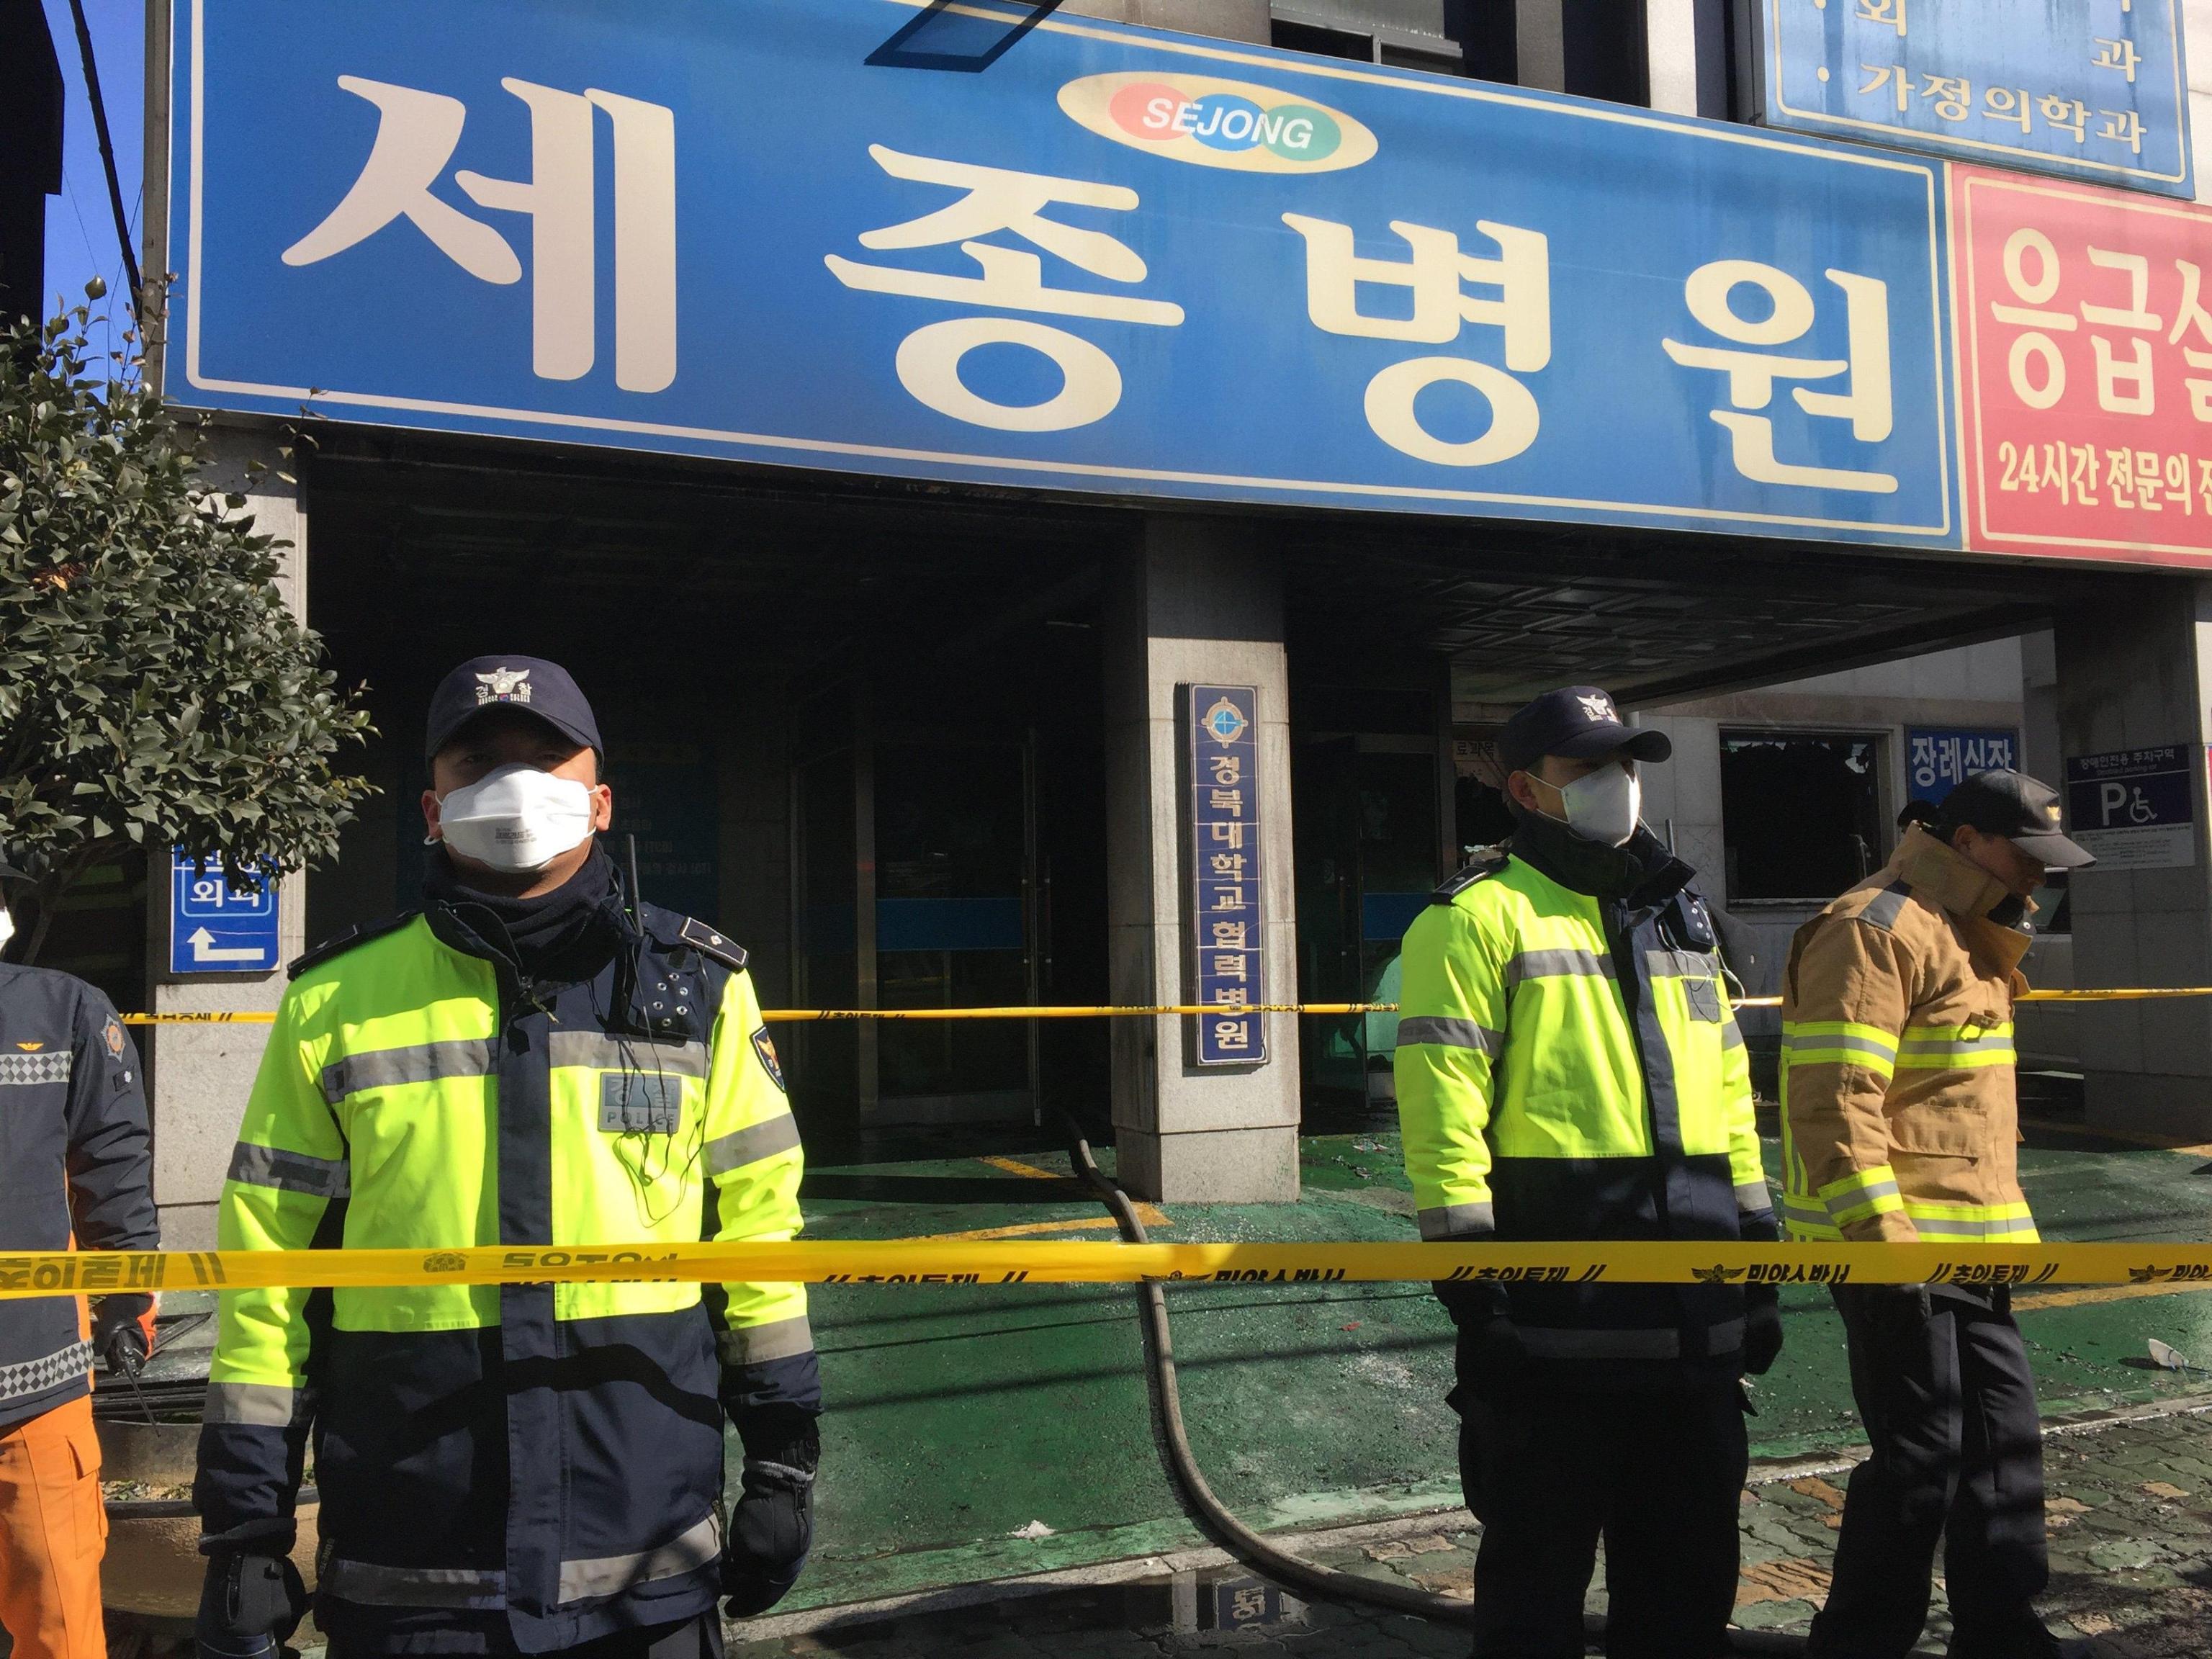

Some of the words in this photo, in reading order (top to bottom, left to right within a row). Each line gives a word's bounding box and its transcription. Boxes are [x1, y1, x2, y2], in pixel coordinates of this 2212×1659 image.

[2092, 37, 2141, 82] 과
[1142, 97, 1314, 149] SEJONG
[1858, 63, 2147, 154] 가정의학과
[281, 74, 1899, 493] 세종병원
[1998, 440, 2100, 505] 24시간
[2105, 446, 2193, 516] 전문의
[2080, 754, 2129, 771] 장애인전용
[2134, 748, 2175, 762] 주차구역
[1210, 756, 1247, 912] 경북대학교
[2100, 782, 2127, 826] P
[1212, 921, 1248, 1050] 협력병원
